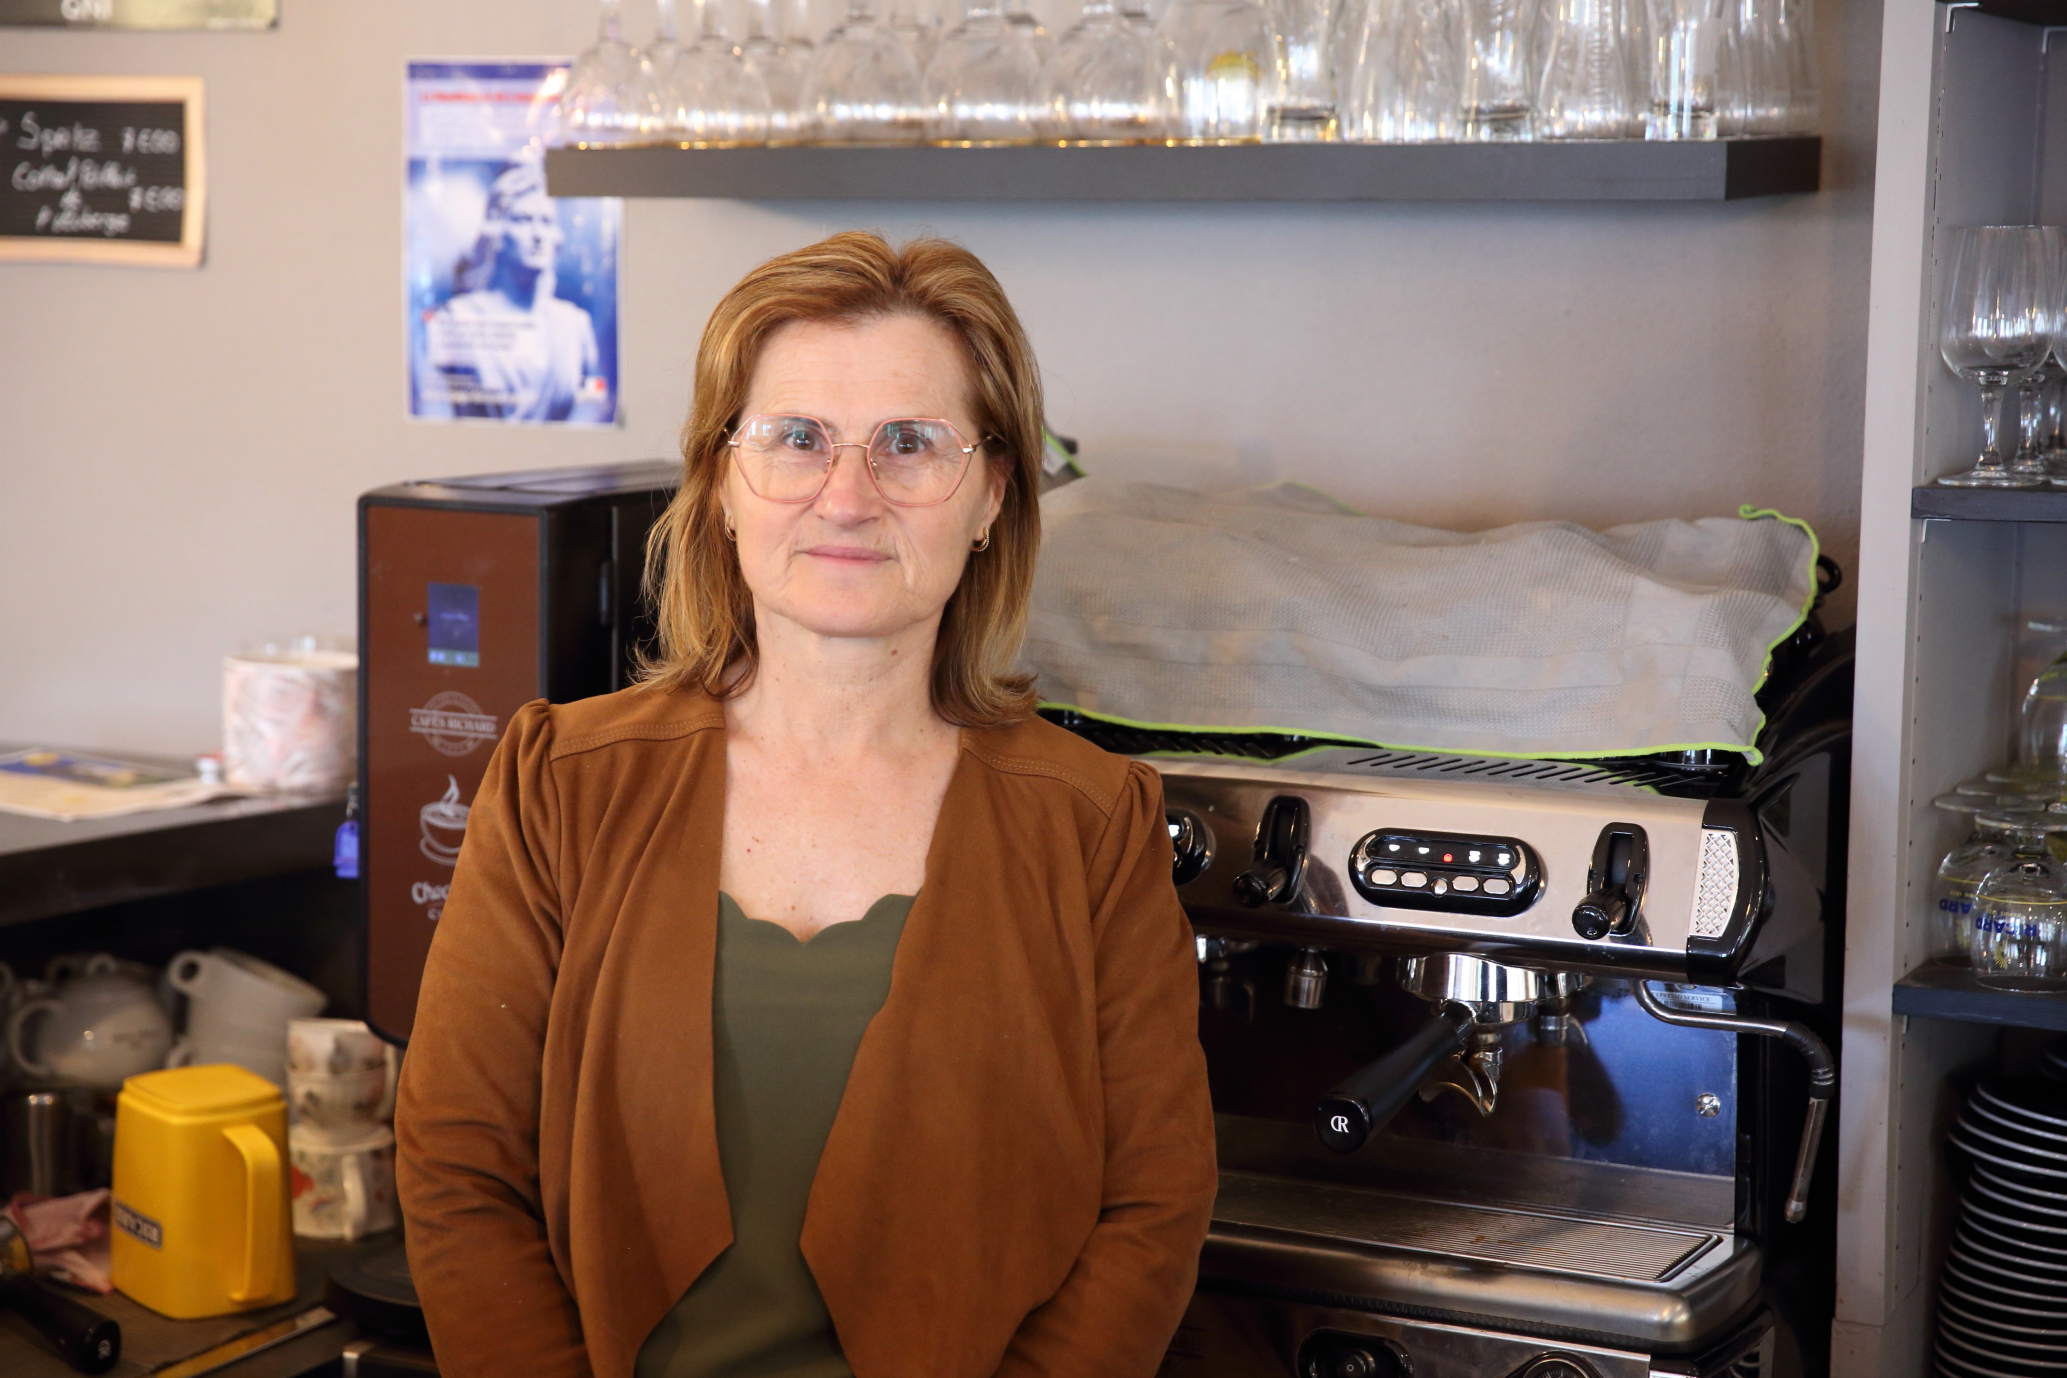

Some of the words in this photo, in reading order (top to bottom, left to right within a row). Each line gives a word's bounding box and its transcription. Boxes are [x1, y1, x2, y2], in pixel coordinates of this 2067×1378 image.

[1975, 917, 2037, 937] RICARD
[1653, 992, 1683, 1000] XPRESSO
[1684, 994, 1711, 1002] SERVICE
